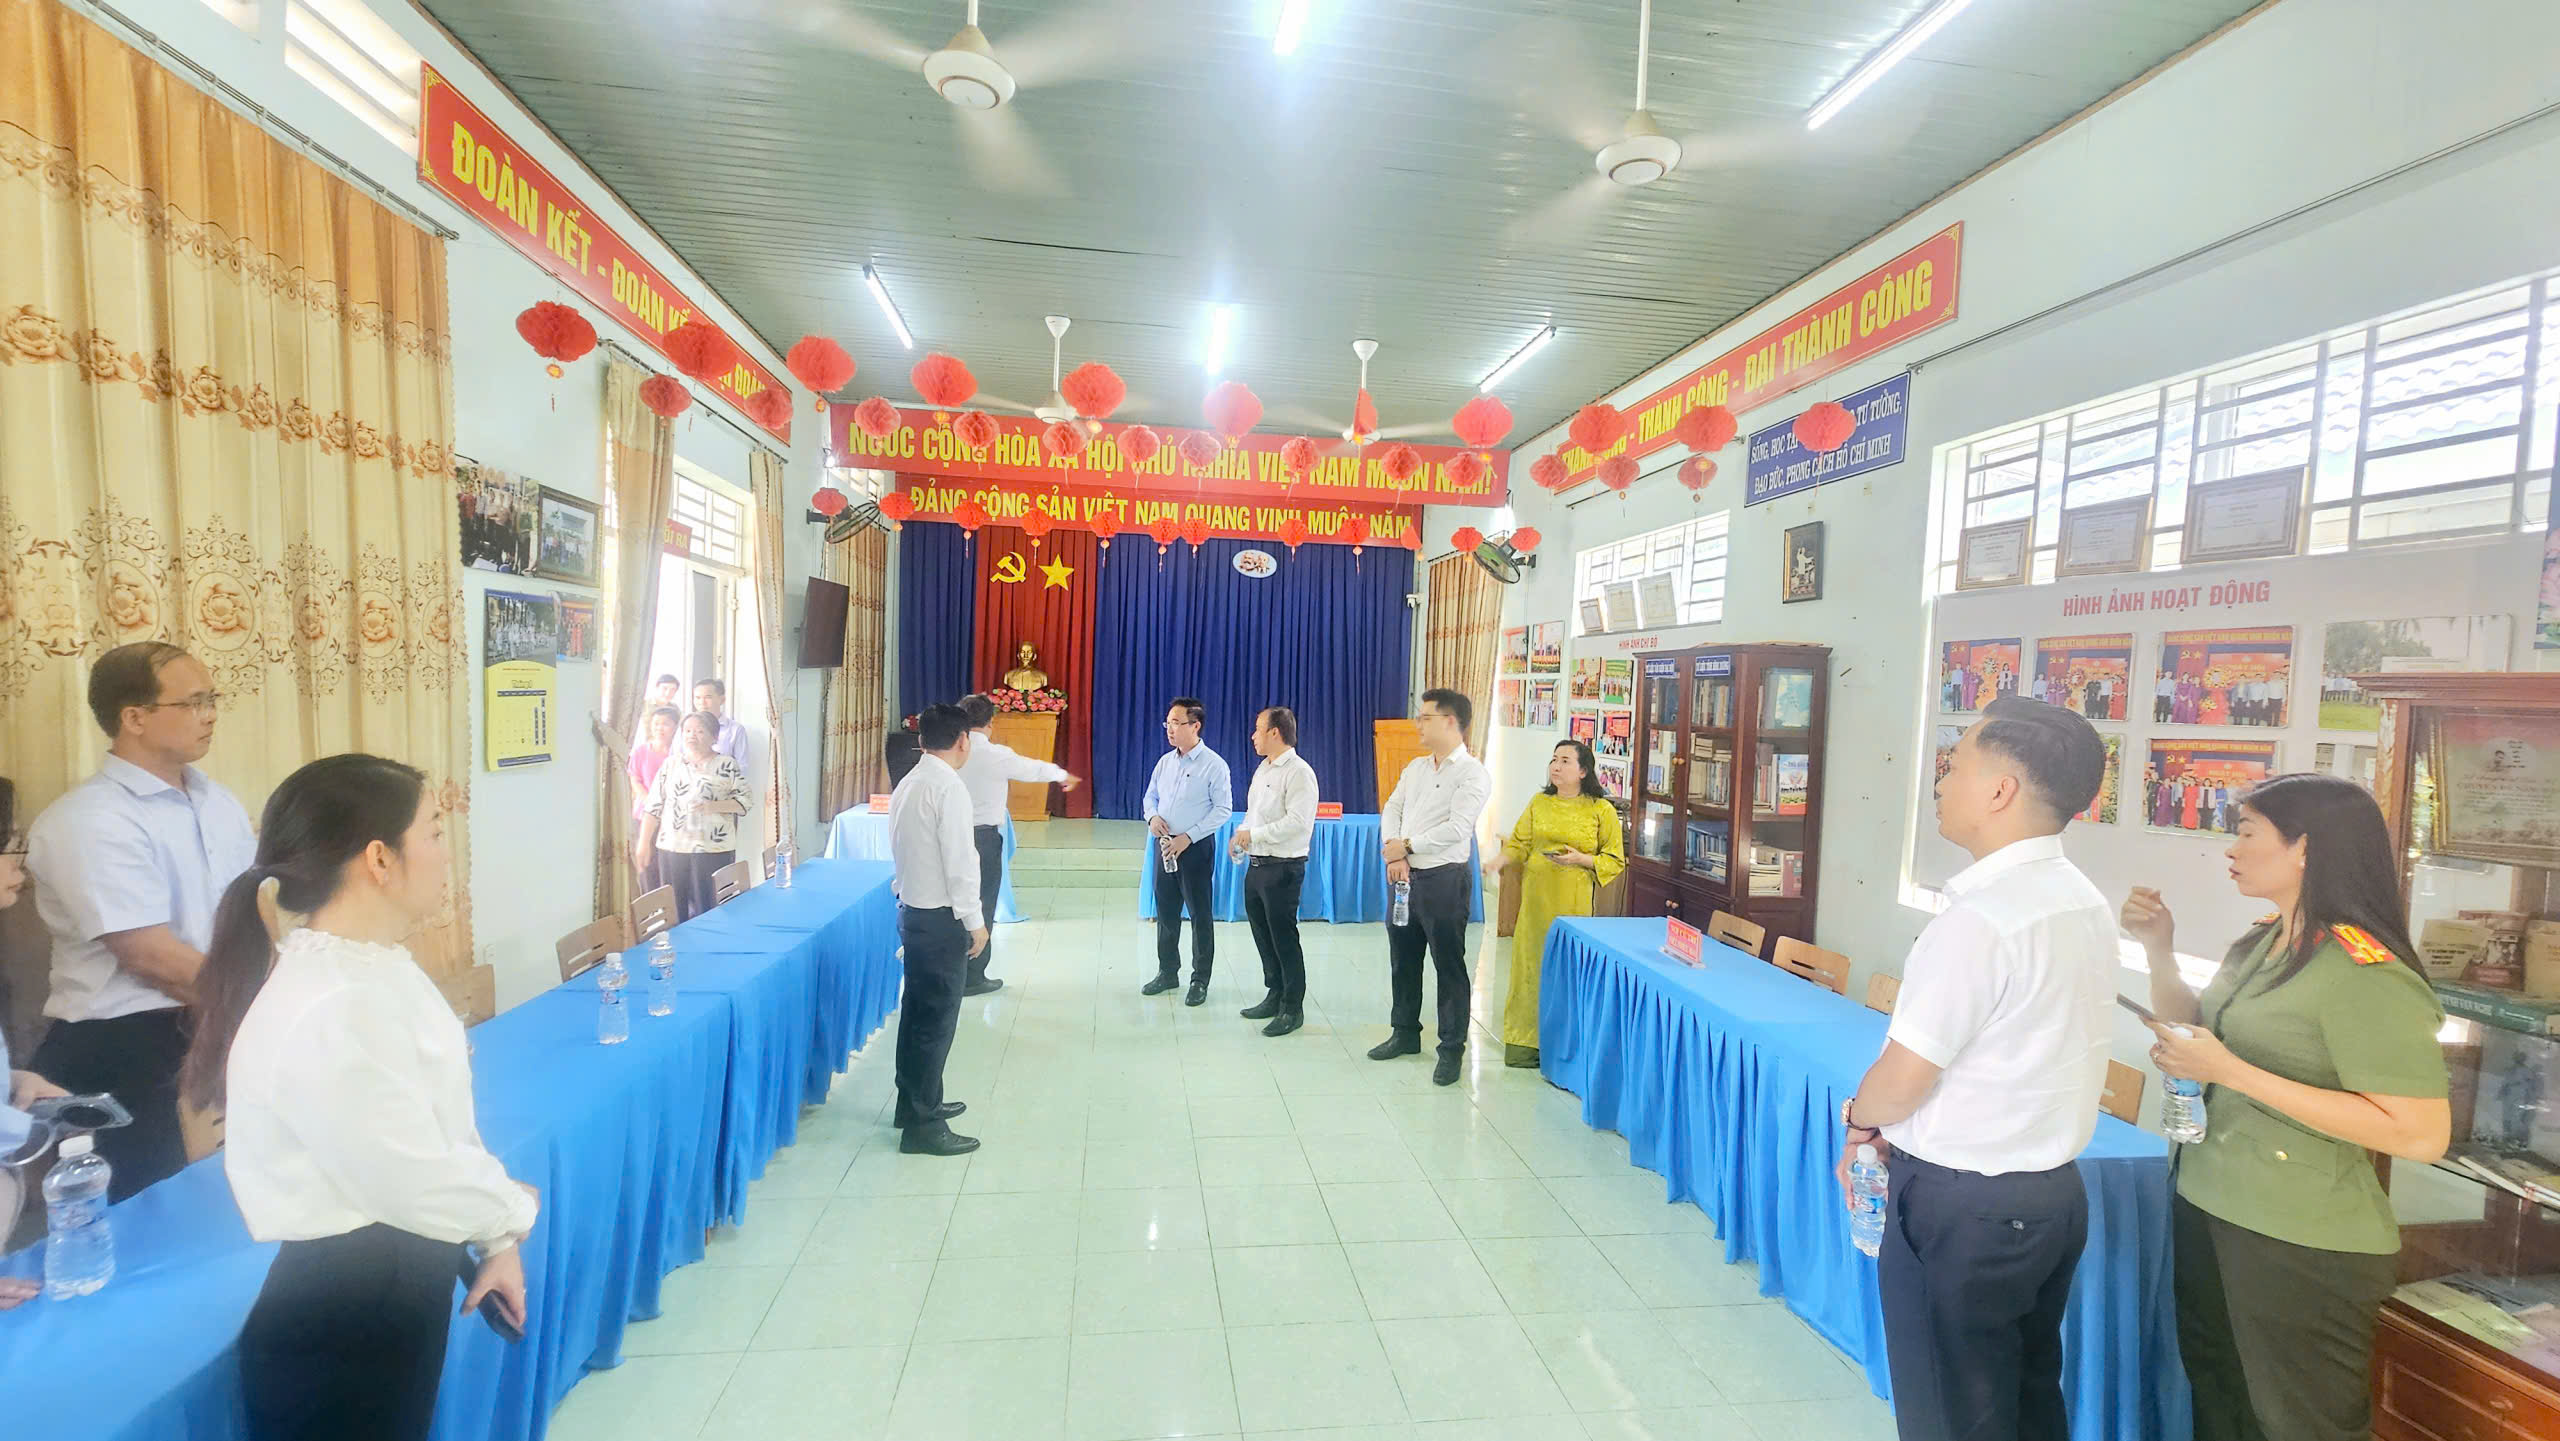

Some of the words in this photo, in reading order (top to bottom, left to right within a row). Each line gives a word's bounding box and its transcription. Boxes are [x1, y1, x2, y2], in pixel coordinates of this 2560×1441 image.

[452, 121, 538, 238] ĐOÀN
[546, 201, 592, 277] KẾT
[611, 257, 664, 335] ĐOÀN
[1638, 393, 1683, 444] THÀNH
[1744, 345, 1776, 394] ĐẠI
[1782, 301, 1853, 376] THÀNH
[1859, 258, 1933, 338] CÔNG
[995, 426, 1041, 468] HÒA
[1086, 434, 1124, 479] HỘI
[1309, 455, 1361, 488] NAM
[1771, 434, 1786, 459] HỌC
[1857, 401, 1870, 426] TƯ
[1754, 474, 1768, 497] ĐẠO
[1786, 460, 1811, 485] PHONG
[1812, 451, 1834, 477] CÁCH
[1850, 436, 1866, 466] CHÍ
[1867, 433, 1891, 460] MINH
[974, 484, 1029, 521] CỘNG
[1036, 485, 1076, 521] SẢN
[1136, 500, 1179, 525] NAM
[1308, 505, 1363, 536] MUÔ
[2063, 593, 2102, 617] HÌNH
[2107, 588, 2144, 613] ẢNH
[2150, 586, 2202, 612] HOẠT
[2209, 579, 2271, 609] ĐỘNG
